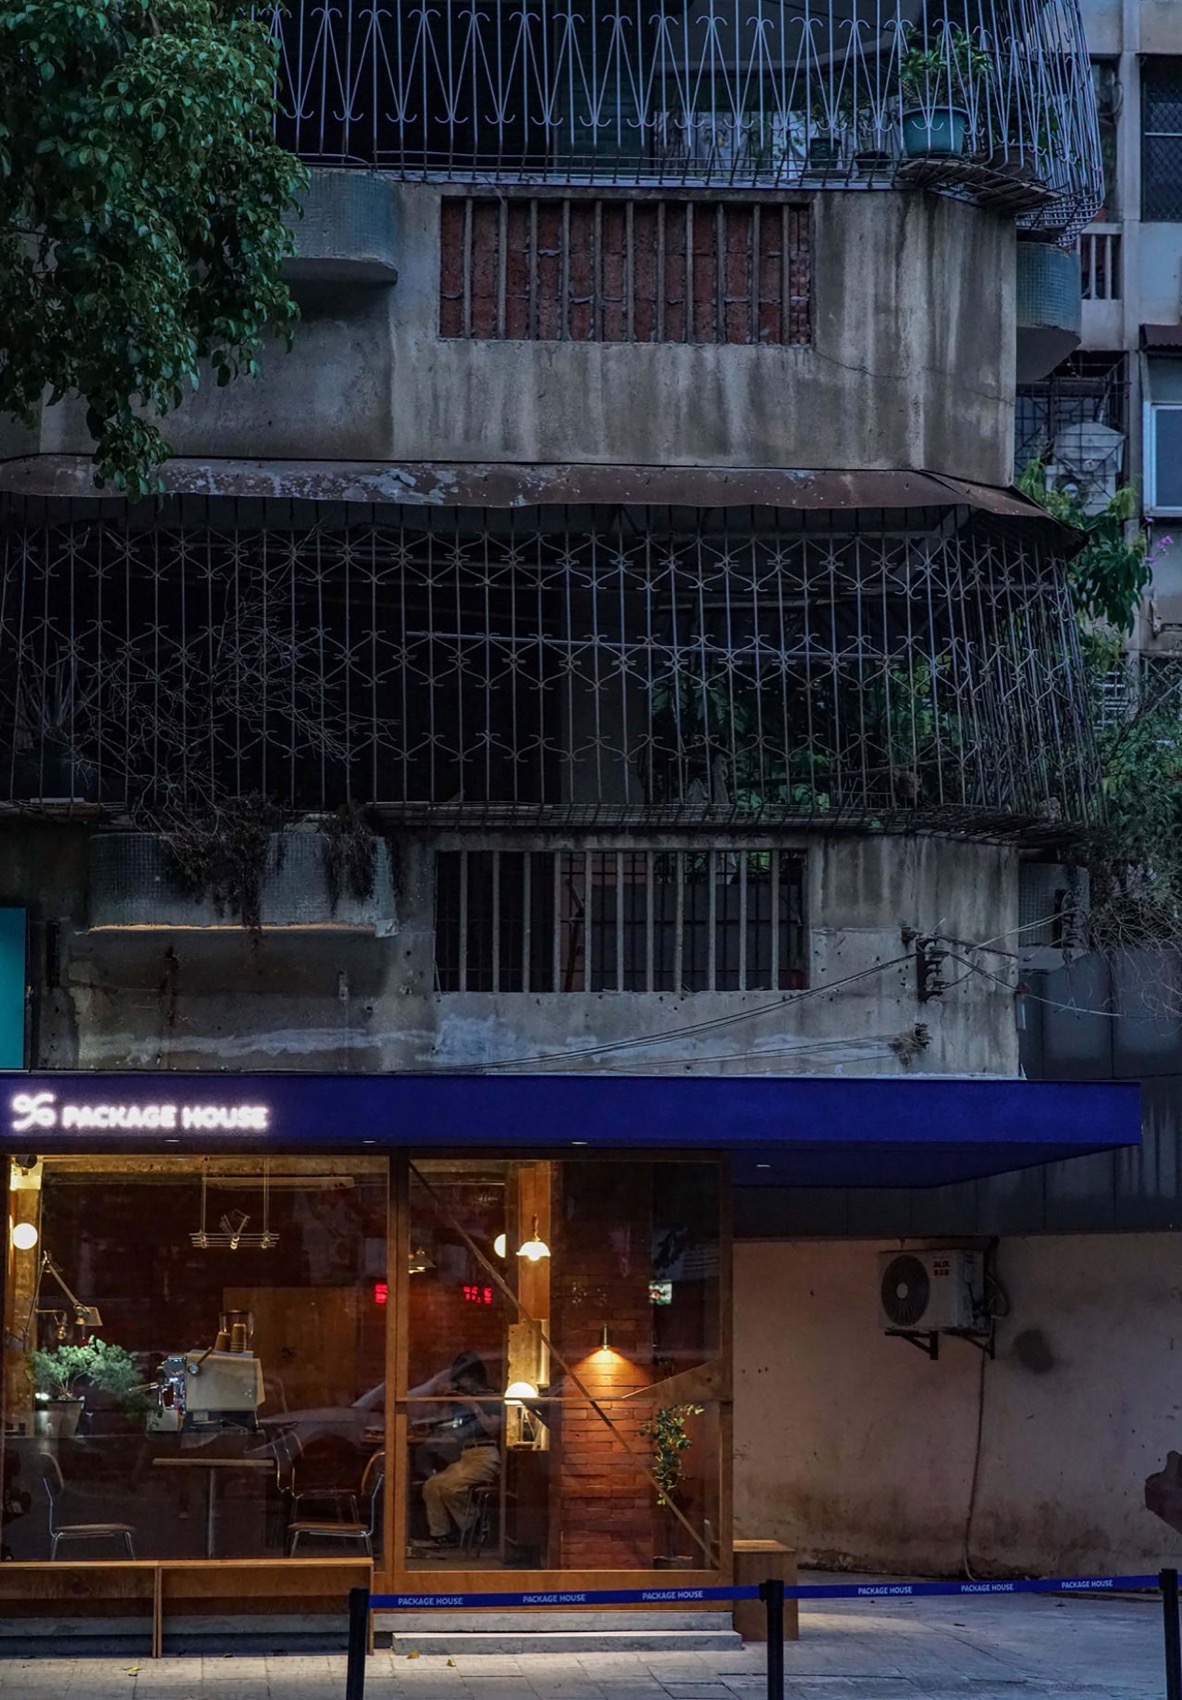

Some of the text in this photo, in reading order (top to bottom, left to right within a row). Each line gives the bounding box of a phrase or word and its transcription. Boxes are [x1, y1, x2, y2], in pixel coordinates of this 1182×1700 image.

[62, 1105, 177, 1128] PACKAGE
[181, 1105, 269, 1129] HOUSE
[960, 1583, 1014, 1592] PACKAGE HOUSE
[1061, 1581, 1090, 1589] PACKAGE
[642, 1590, 704, 1600] PACKAGE HOUSE
[857, 1586, 912, 1595] PACKAGE HOUSE
[397, 1597, 463, 1606] PACKAGE HOUSE
[522, 1594, 586, 1603] PACKAGE HOUSE
